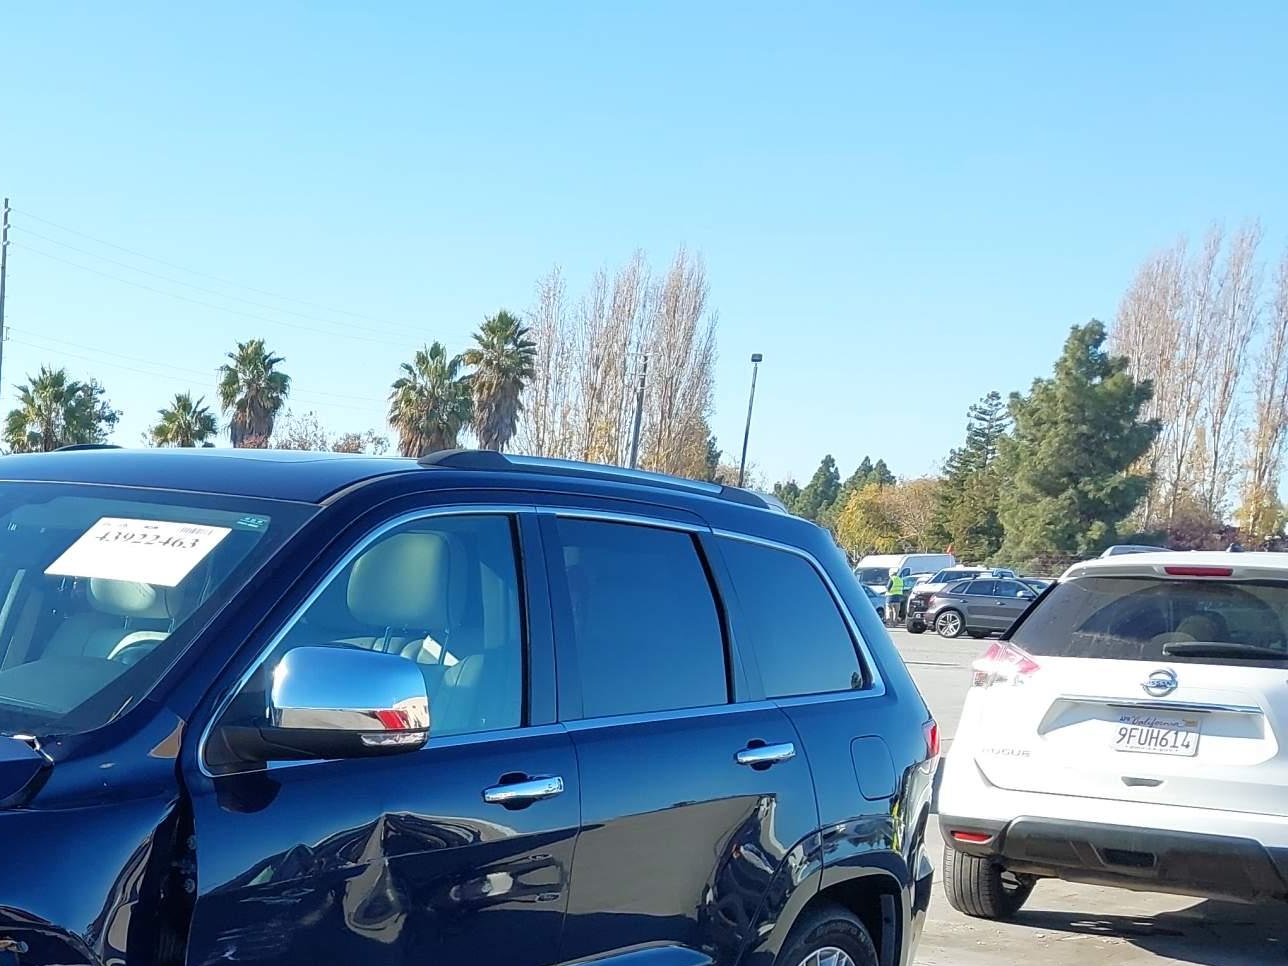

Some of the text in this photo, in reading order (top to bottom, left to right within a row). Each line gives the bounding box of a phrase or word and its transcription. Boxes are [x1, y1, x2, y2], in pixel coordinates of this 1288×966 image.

[95, 531, 200, 549] 43922463
[1132, 715, 1184, 728] California
[1116, 727, 1191, 749] 9FUH614
